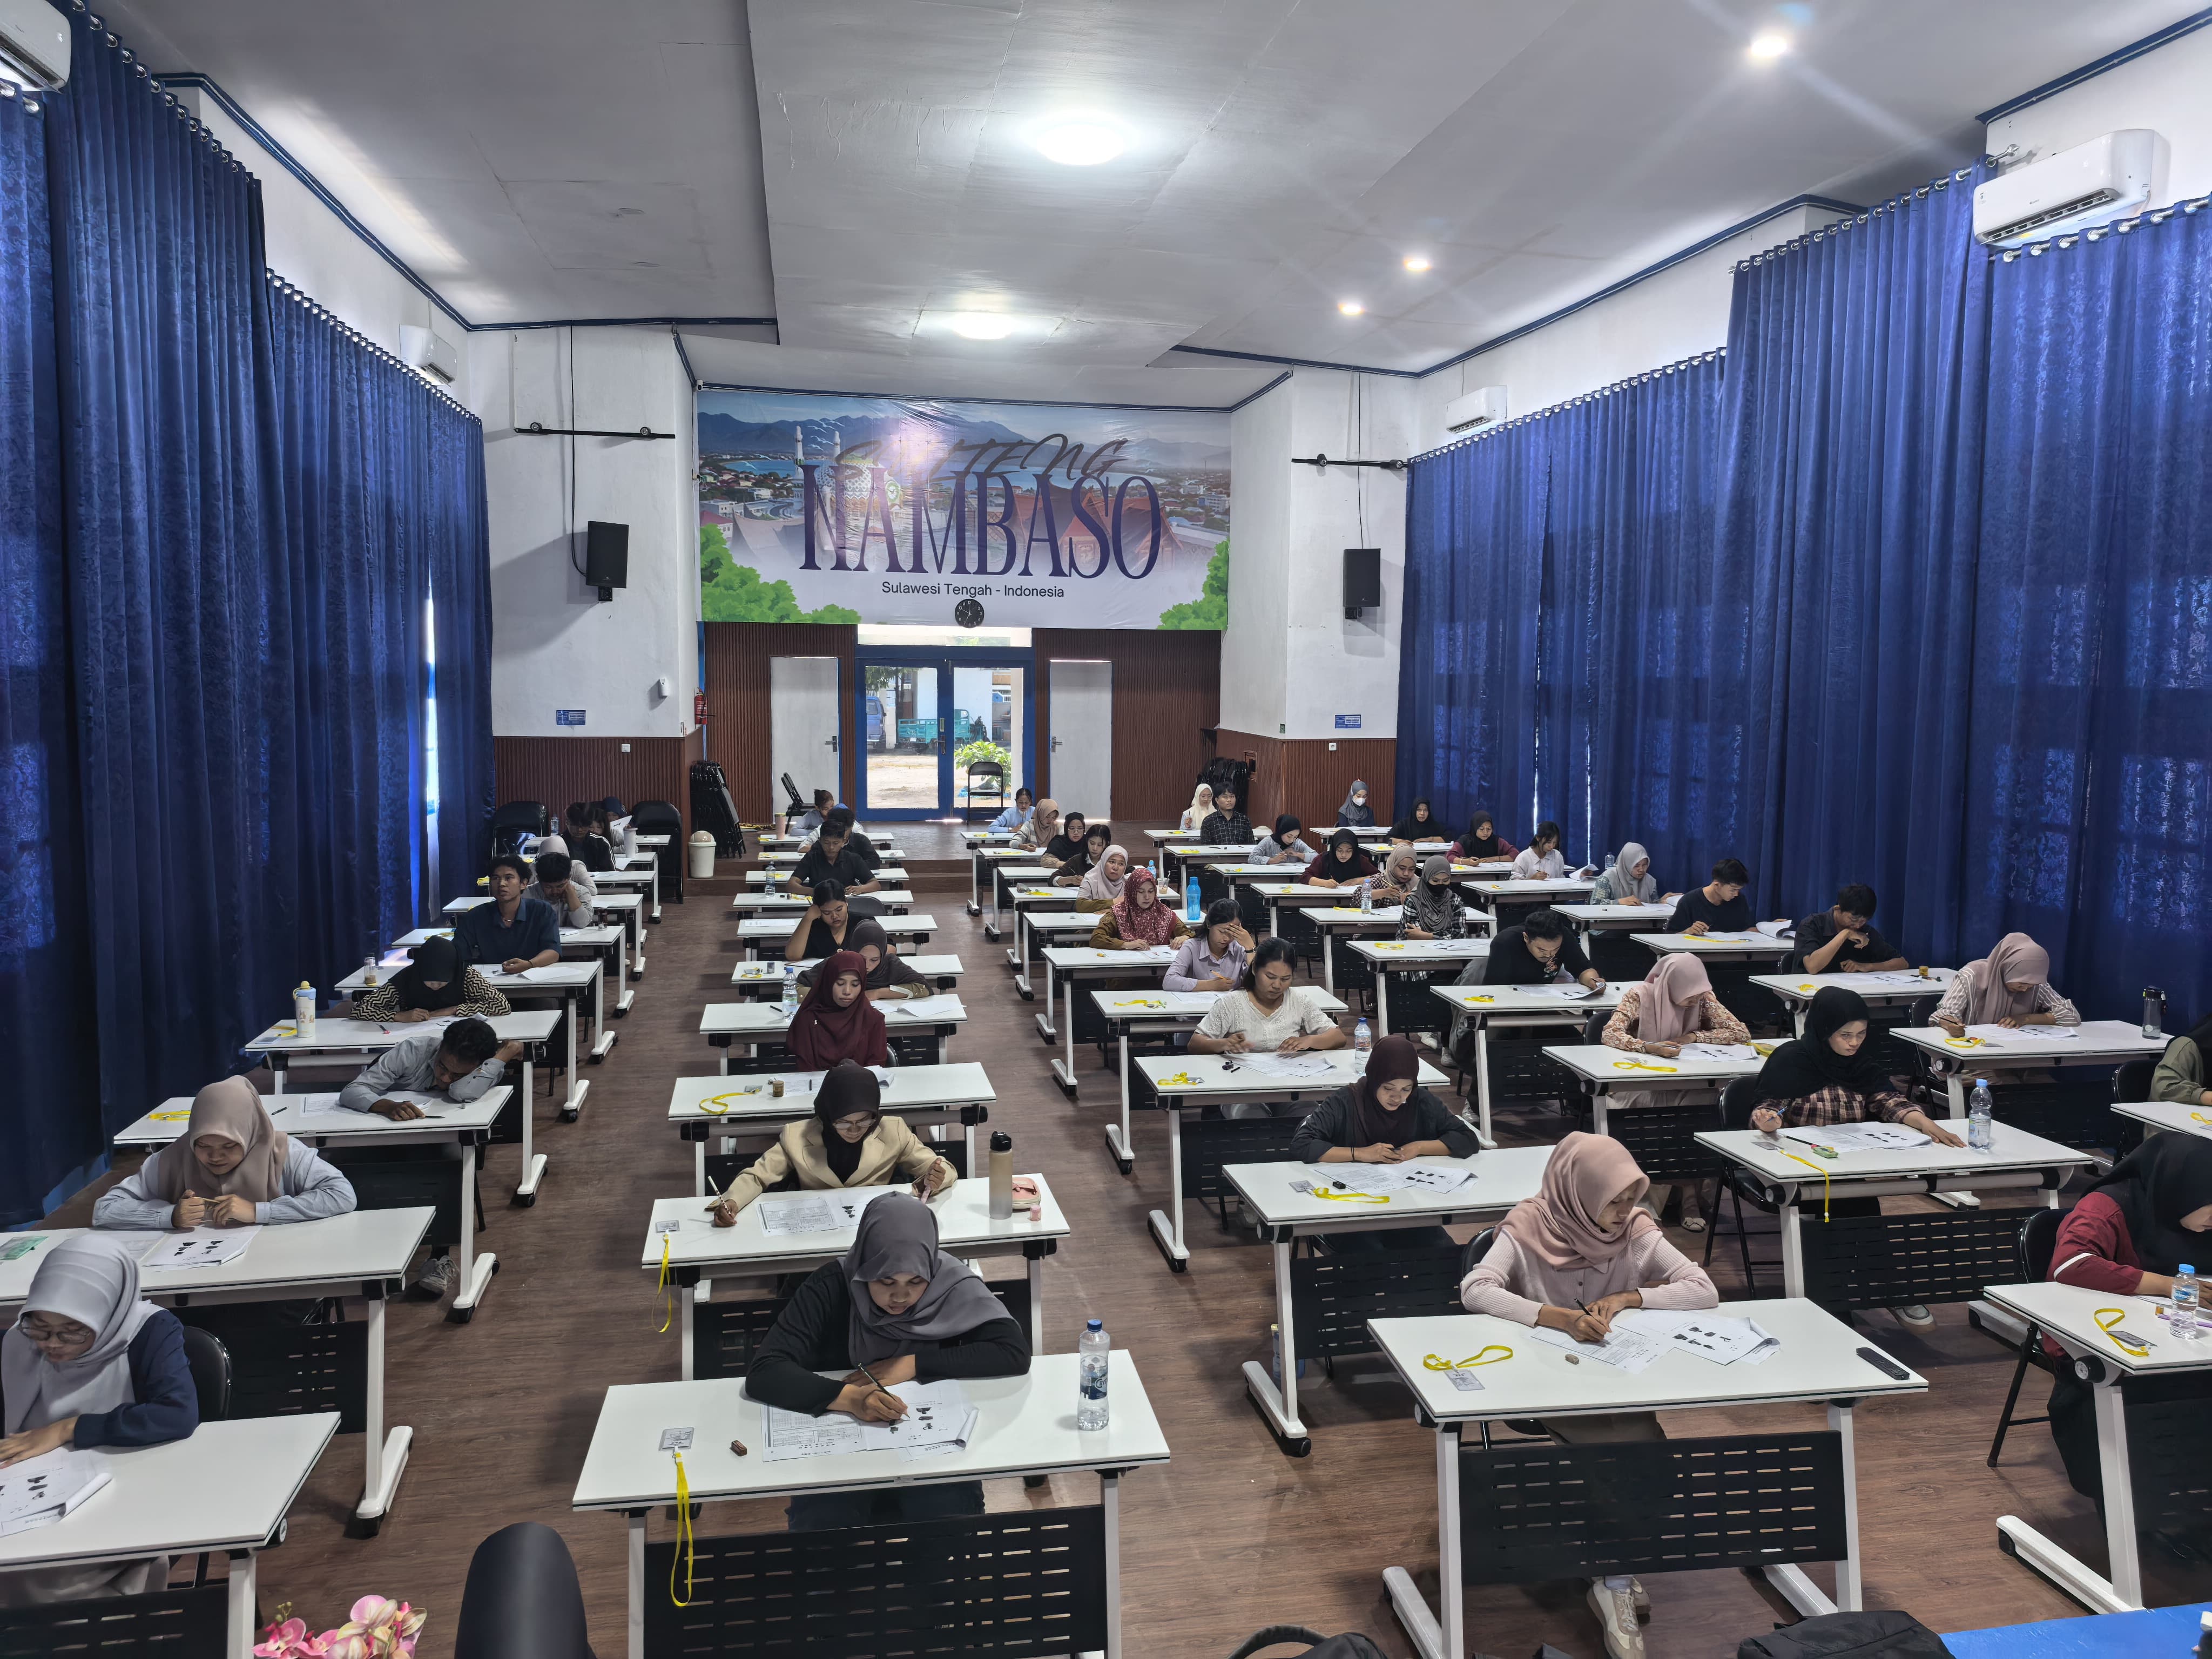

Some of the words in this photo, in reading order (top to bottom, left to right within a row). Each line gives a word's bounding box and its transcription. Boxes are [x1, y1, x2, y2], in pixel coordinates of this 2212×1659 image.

[800, 464, 1161, 579] NAMBASO
[882, 582, 940, 594] Sulawesi
[945, 583, 992, 598] Tengah
[1004, 585, 1064, 597] Indonesia
